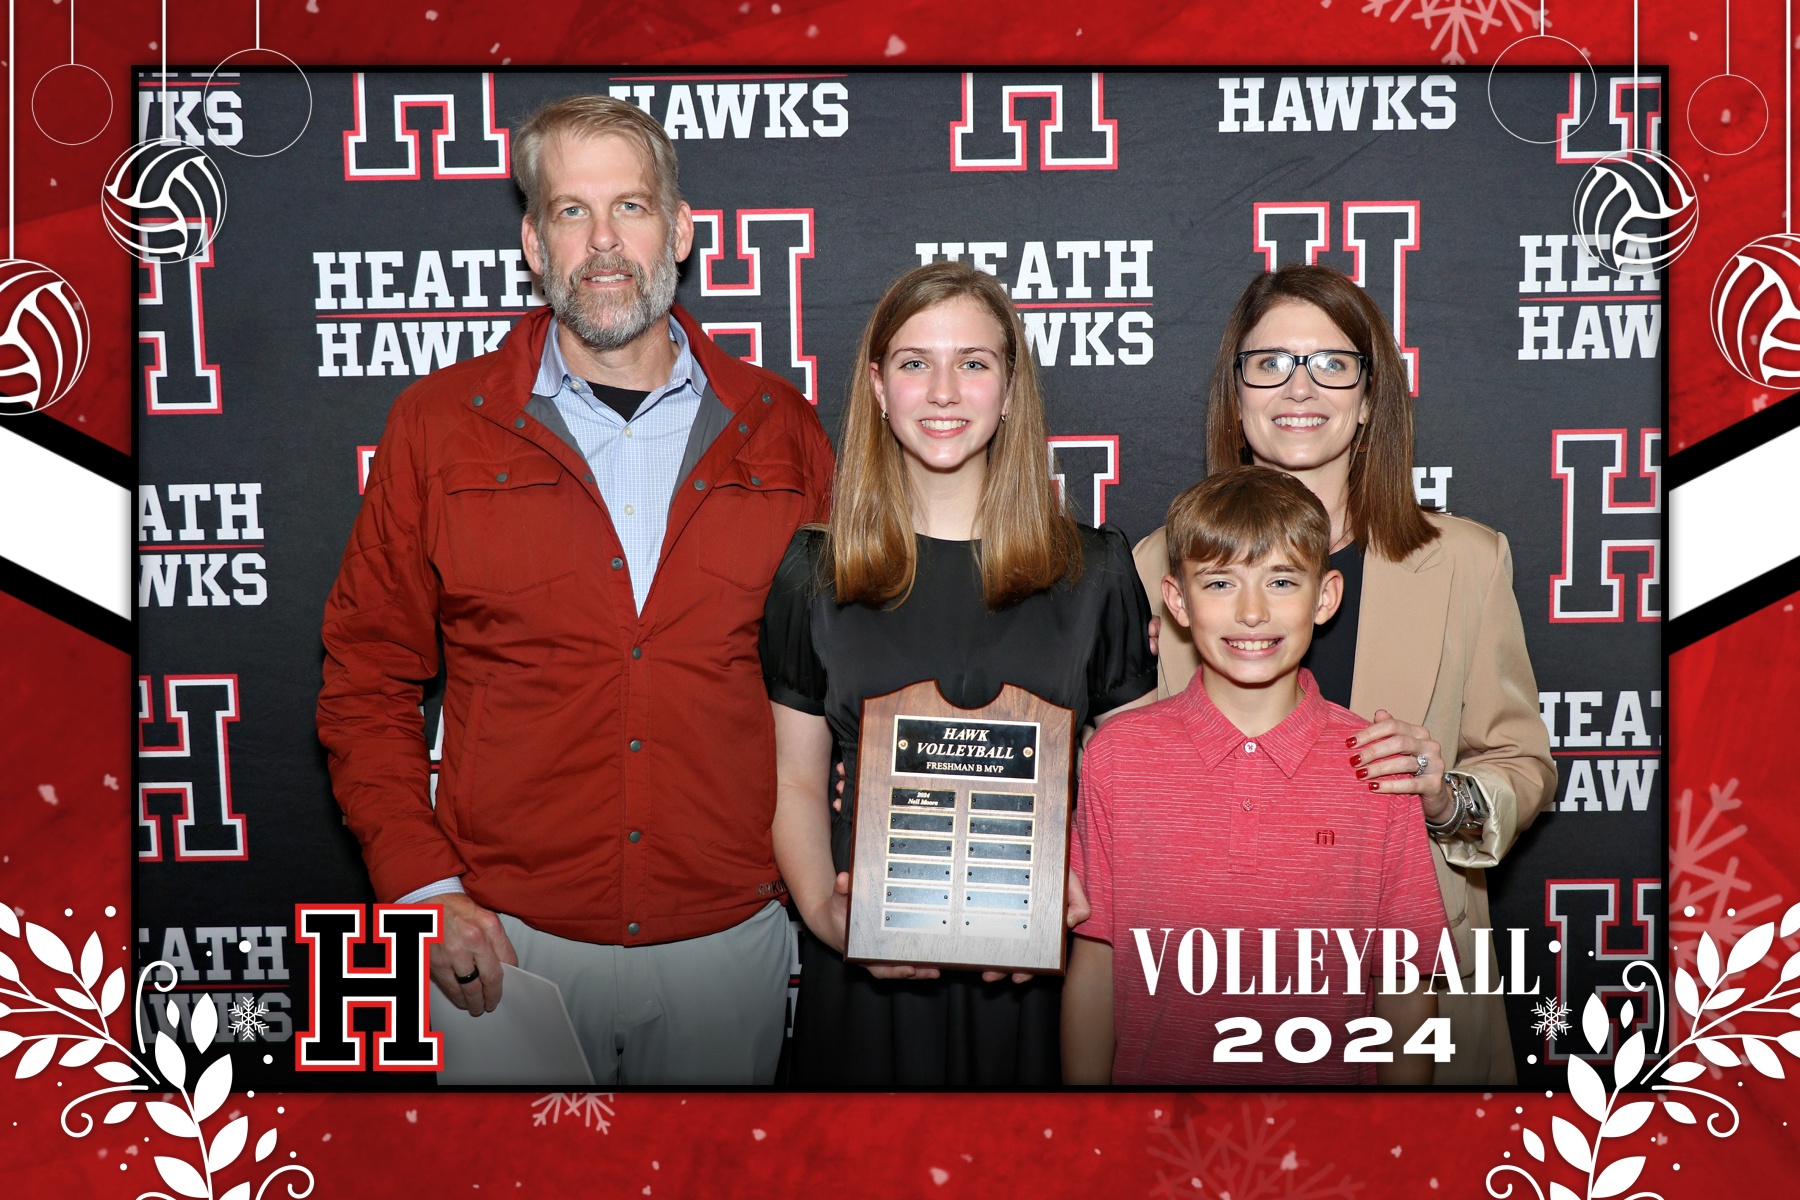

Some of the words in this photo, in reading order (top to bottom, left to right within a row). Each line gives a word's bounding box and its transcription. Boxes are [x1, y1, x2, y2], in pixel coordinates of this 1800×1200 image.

[139, 91, 243, 147] KS
[1218, 75, 1457, 133] HAWKS
[313, 249, 549, 310] HEATH
[917, 742, 1015, 760] VOLLEYBALL
[943, 727, 990, 742] HAWK
[926, 761, 975, 773] FRESHMAN
[976, 764, 983, 773] B
[984, 765, 1004, 774] MVP
[1540, 759, 1659, 812] AW
[139, 926, 290, 982] ATH
[141, 992, 293, 1044] WKS
